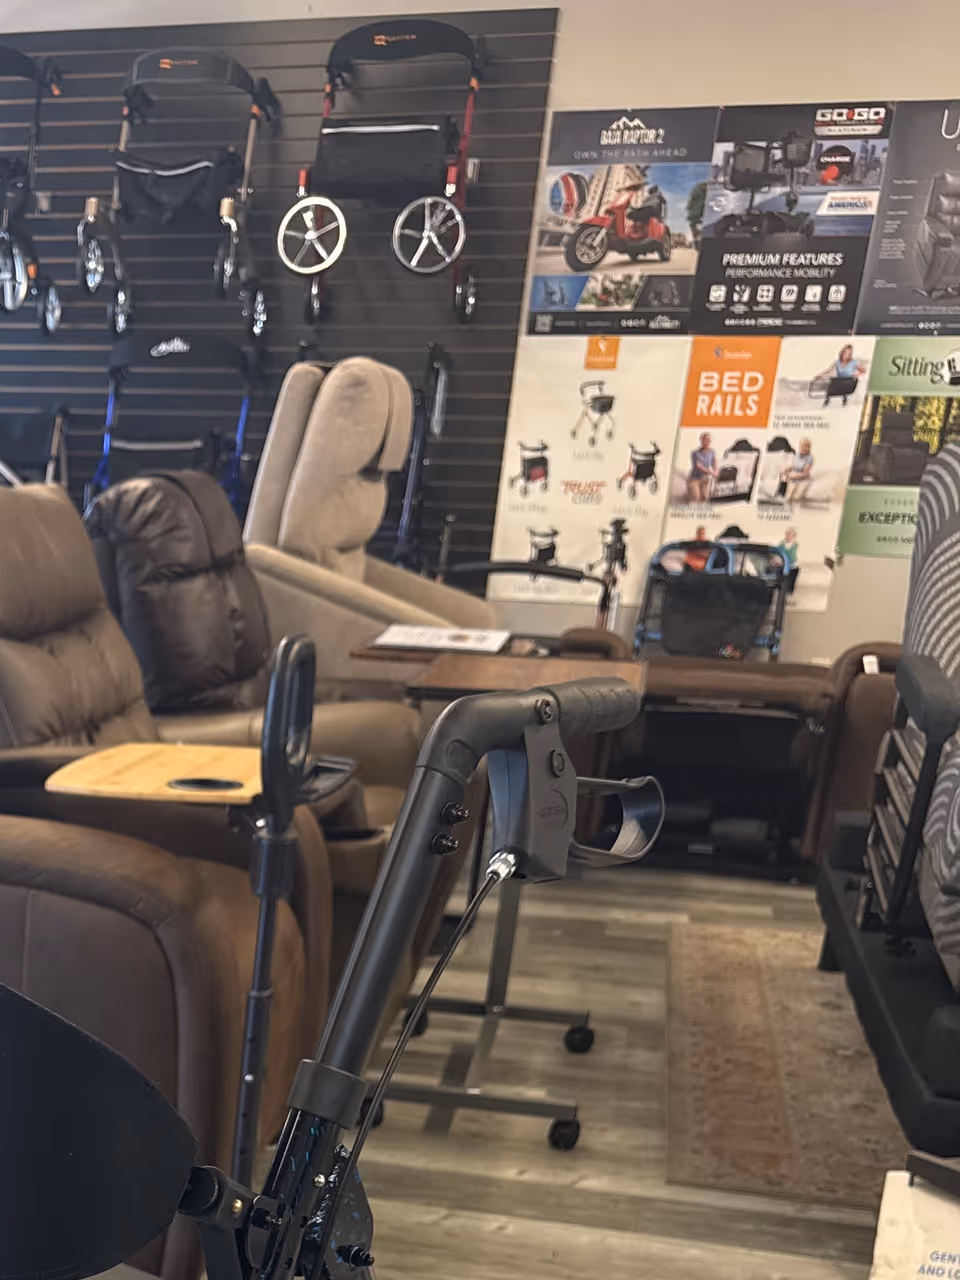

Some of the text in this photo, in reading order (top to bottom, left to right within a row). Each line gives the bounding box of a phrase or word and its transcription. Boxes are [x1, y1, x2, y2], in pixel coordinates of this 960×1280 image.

[622, 129, 656, 144] RAPTOR
[573, 148, 688, 159] OWN THE PATH AHEAD
[722, 252, 844, 266] PREMIUM FEATURES
[725, 268, 837, 278] PERFORMANCE MOBILITY
[889, 355, 945, 385] Sitting
[699, 371, 764, 392] BED
[696, 394, 760, 417] RAILS
[918, 1264, 945, 1278] AND
